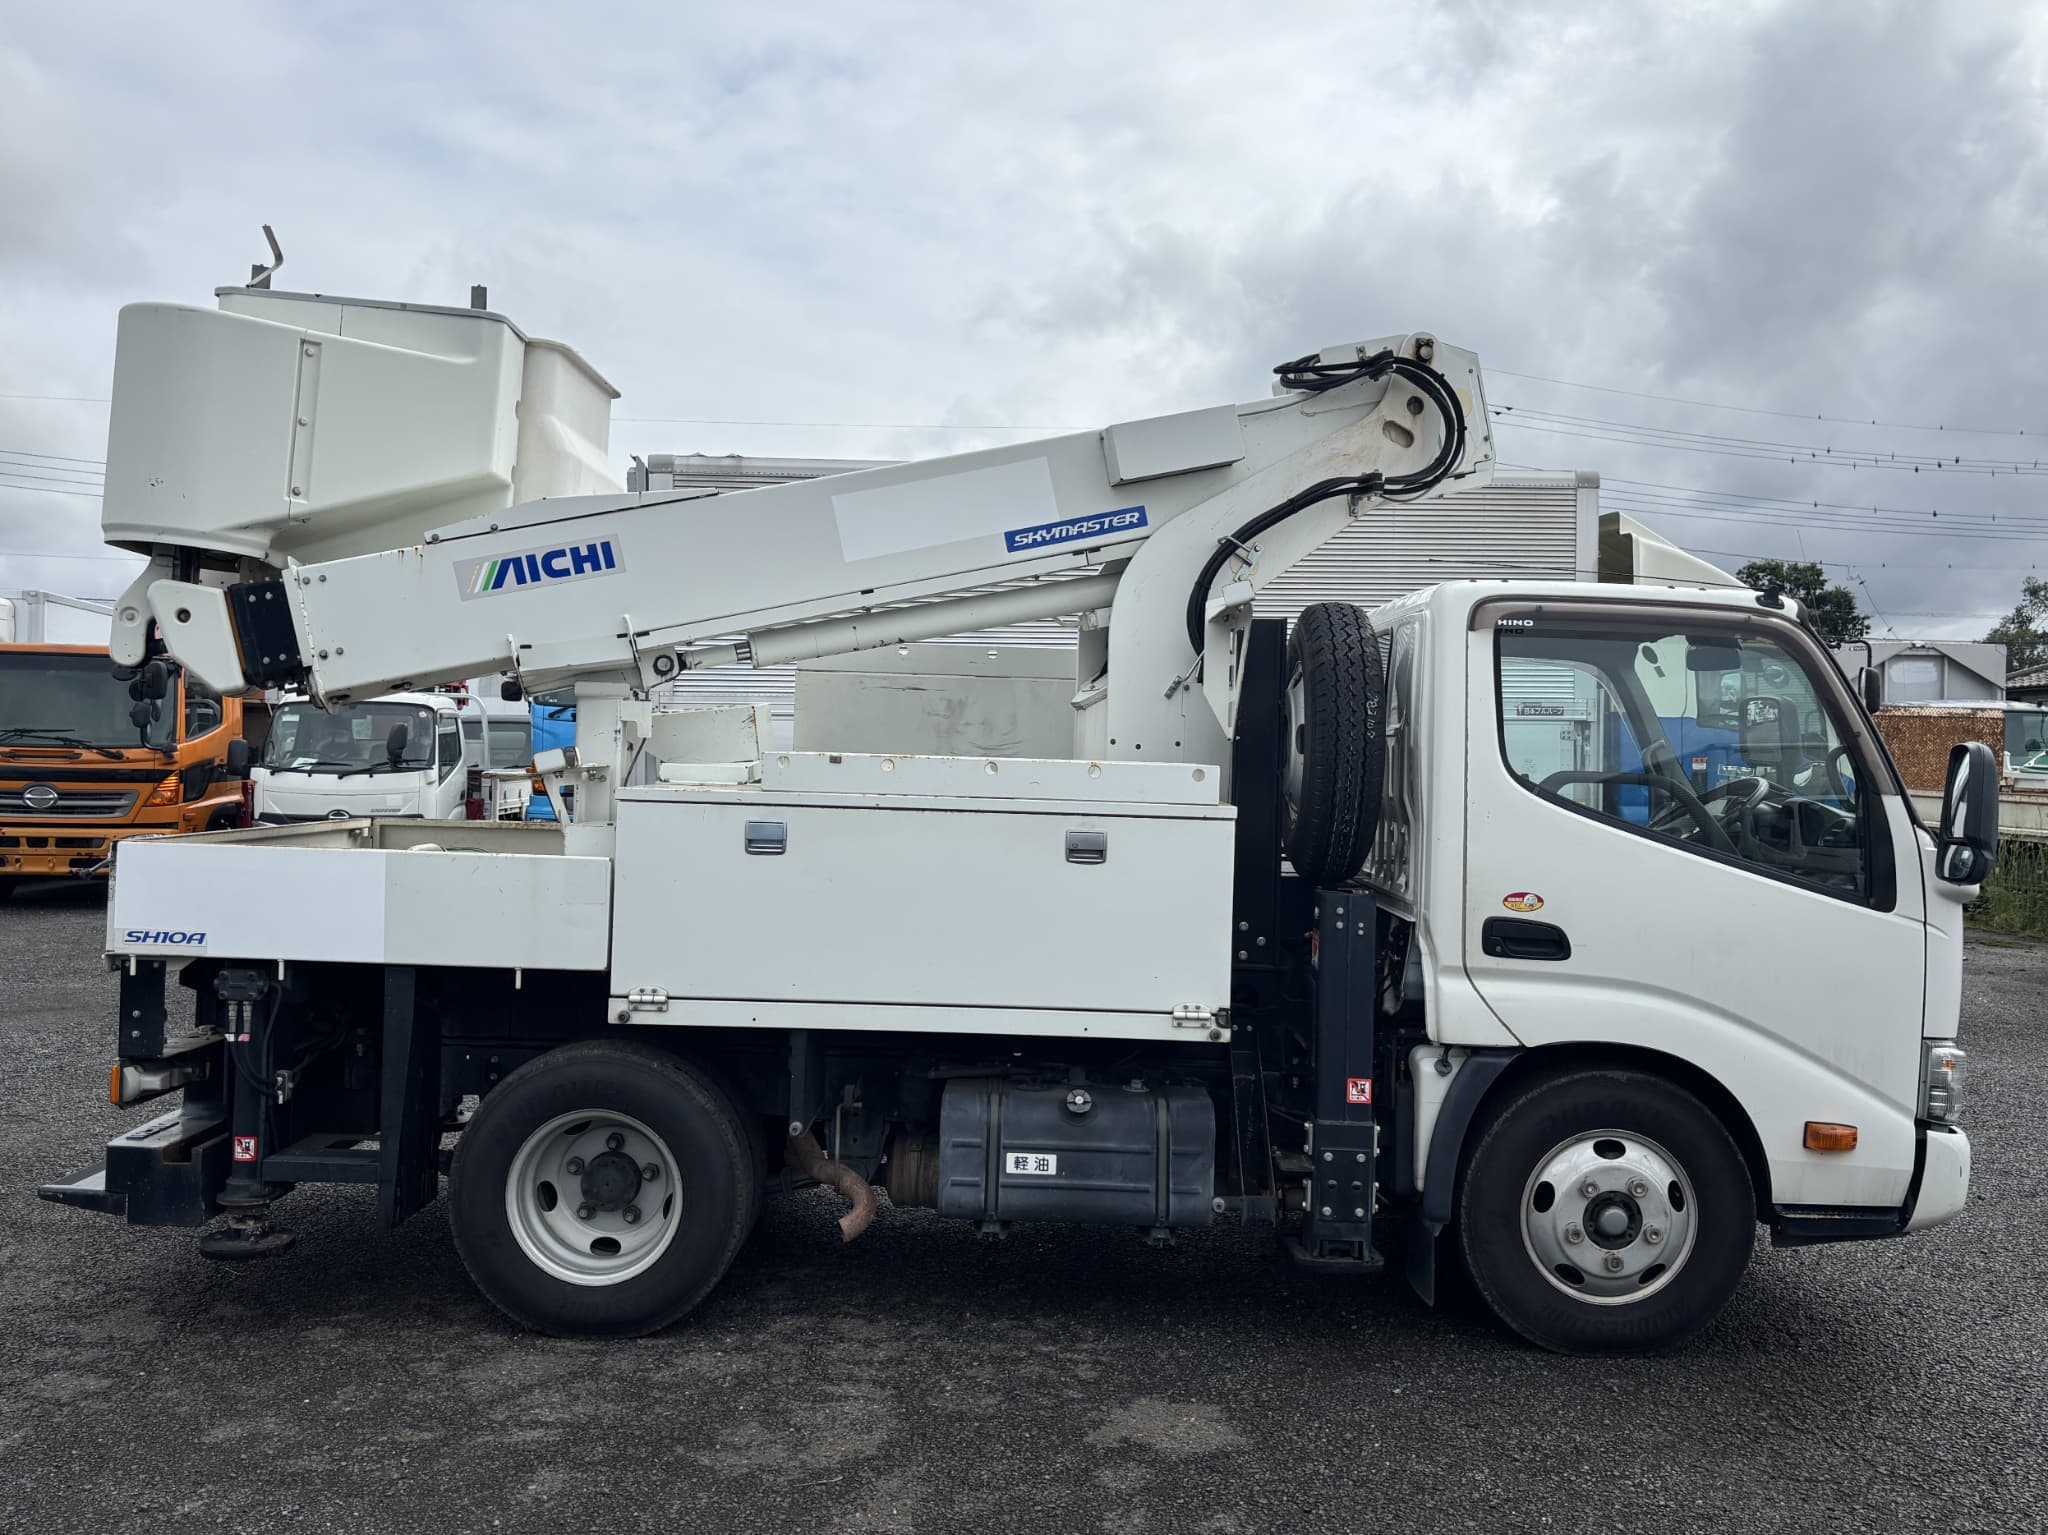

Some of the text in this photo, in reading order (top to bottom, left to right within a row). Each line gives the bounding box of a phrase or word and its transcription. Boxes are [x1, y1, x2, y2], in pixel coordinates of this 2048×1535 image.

[1013, 511, 1140, 547] SKYMASTER
[490, 540, 617, 591] AICHI
[1497, 618, 1534, 627] HINO
[124, 930, 207, 945] SH10A
[1014, 1155, 1049, 1172] 軽油
